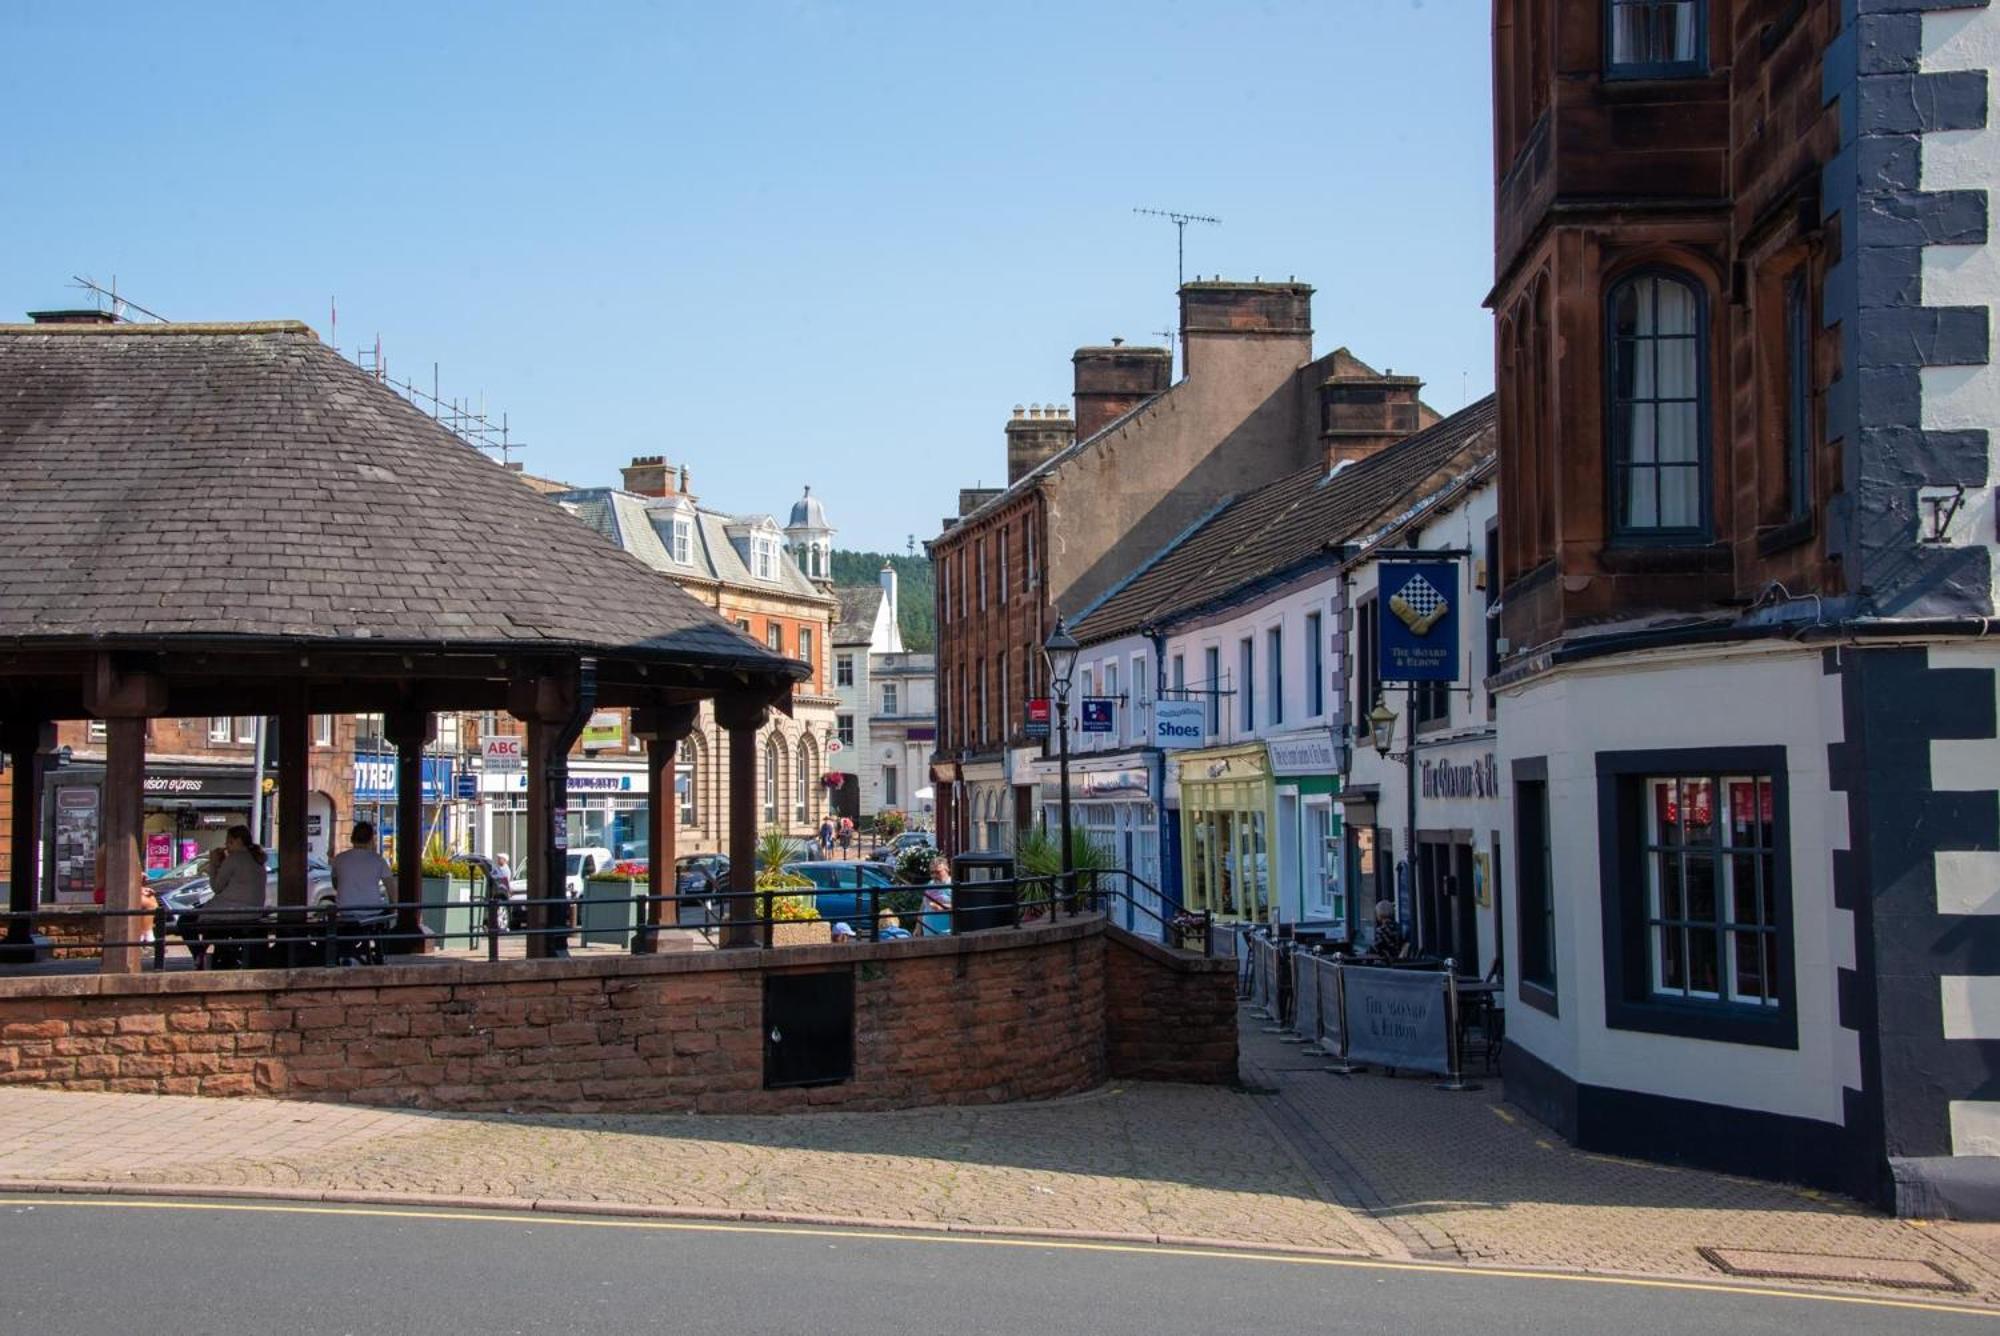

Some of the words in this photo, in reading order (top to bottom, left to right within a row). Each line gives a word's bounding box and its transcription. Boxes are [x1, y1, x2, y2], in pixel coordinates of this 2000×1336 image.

[1158, 721, 1200, 737] Shoes
[487, 741, 518, 754] ABC
[143, 777, 168, 790] vision
[168, 777, 203, 792] express
